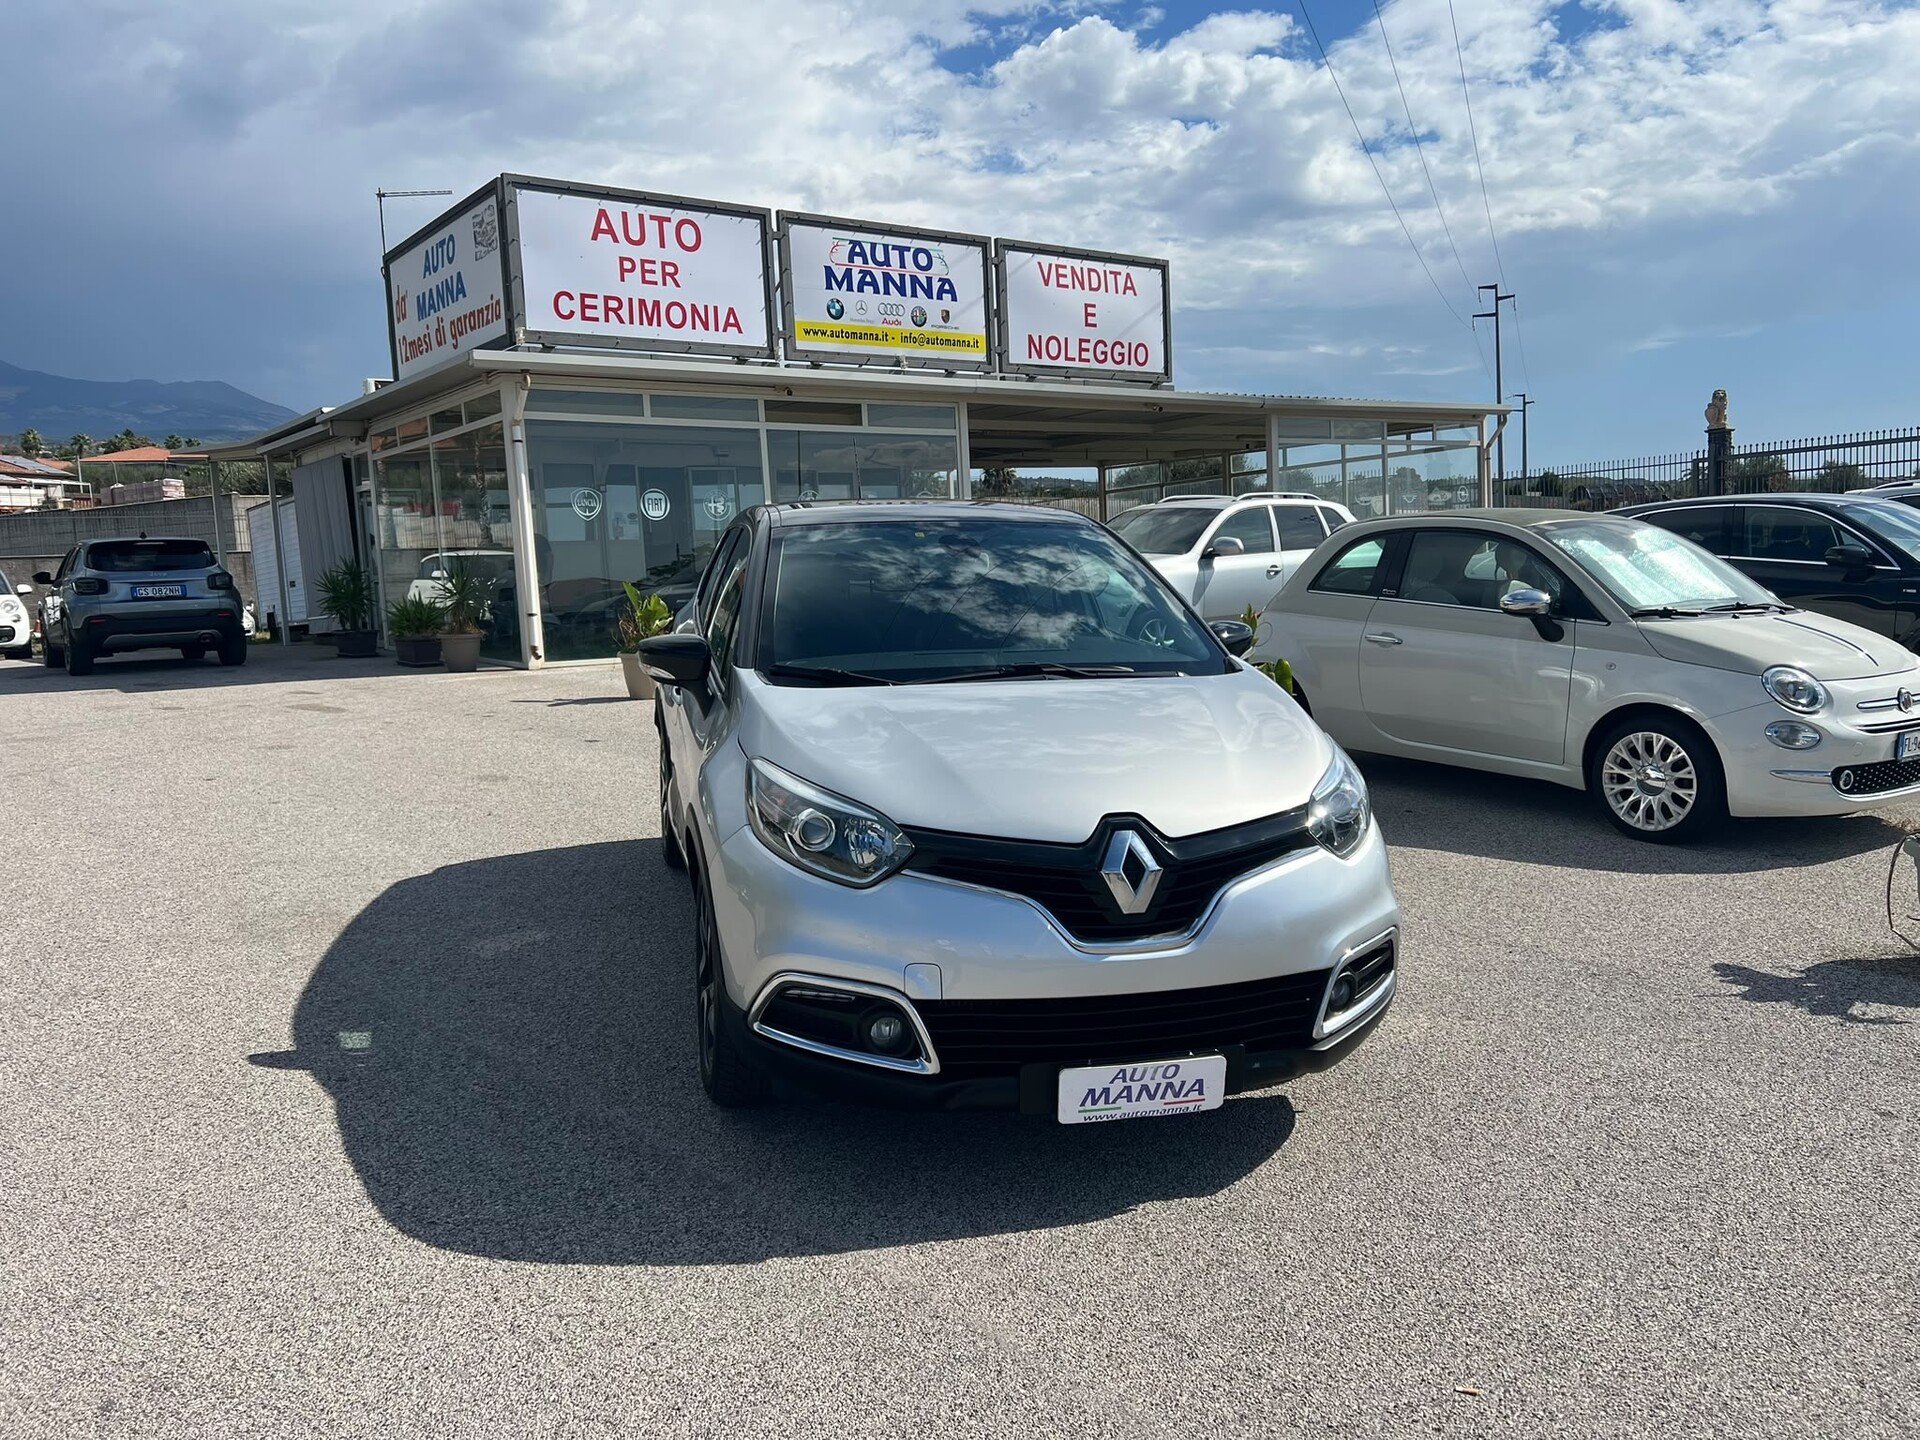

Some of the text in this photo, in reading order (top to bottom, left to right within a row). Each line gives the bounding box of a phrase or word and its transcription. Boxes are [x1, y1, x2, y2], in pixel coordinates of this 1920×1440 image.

[591, 208, 702, 252] AUTO
[423, 234, 456, 279] AUTO
[618, 256, 681, 288] PER
[848, 239, 933, 272] AUTO
[823, 265, 957, 302] MANNA
[1037, 261, 1137, 296] VENDITA
[416, 271, 467, 321] MANNA
[553, 290, 743, 334] CERIMONIA
[435, 316, 446, 348] di
[449, 294, 501, 350] garanzia
[882, 317, 902, 326] Audi
[1084, 303, 1097, 328] E
[803, 326, 889, 344] www.automanna.it
[900, 332, 979, 349] info@automanna.it
[1028, 334, 1149, 367] NOLEGGIO
[647, 497, 663, 512] FIAT
[1109, 1064, 1180, 1084] AUTO
[1079, 1078, 1205, 1107] MANNA
[1083, 1105, 1202, 1122] www.automanna.it
